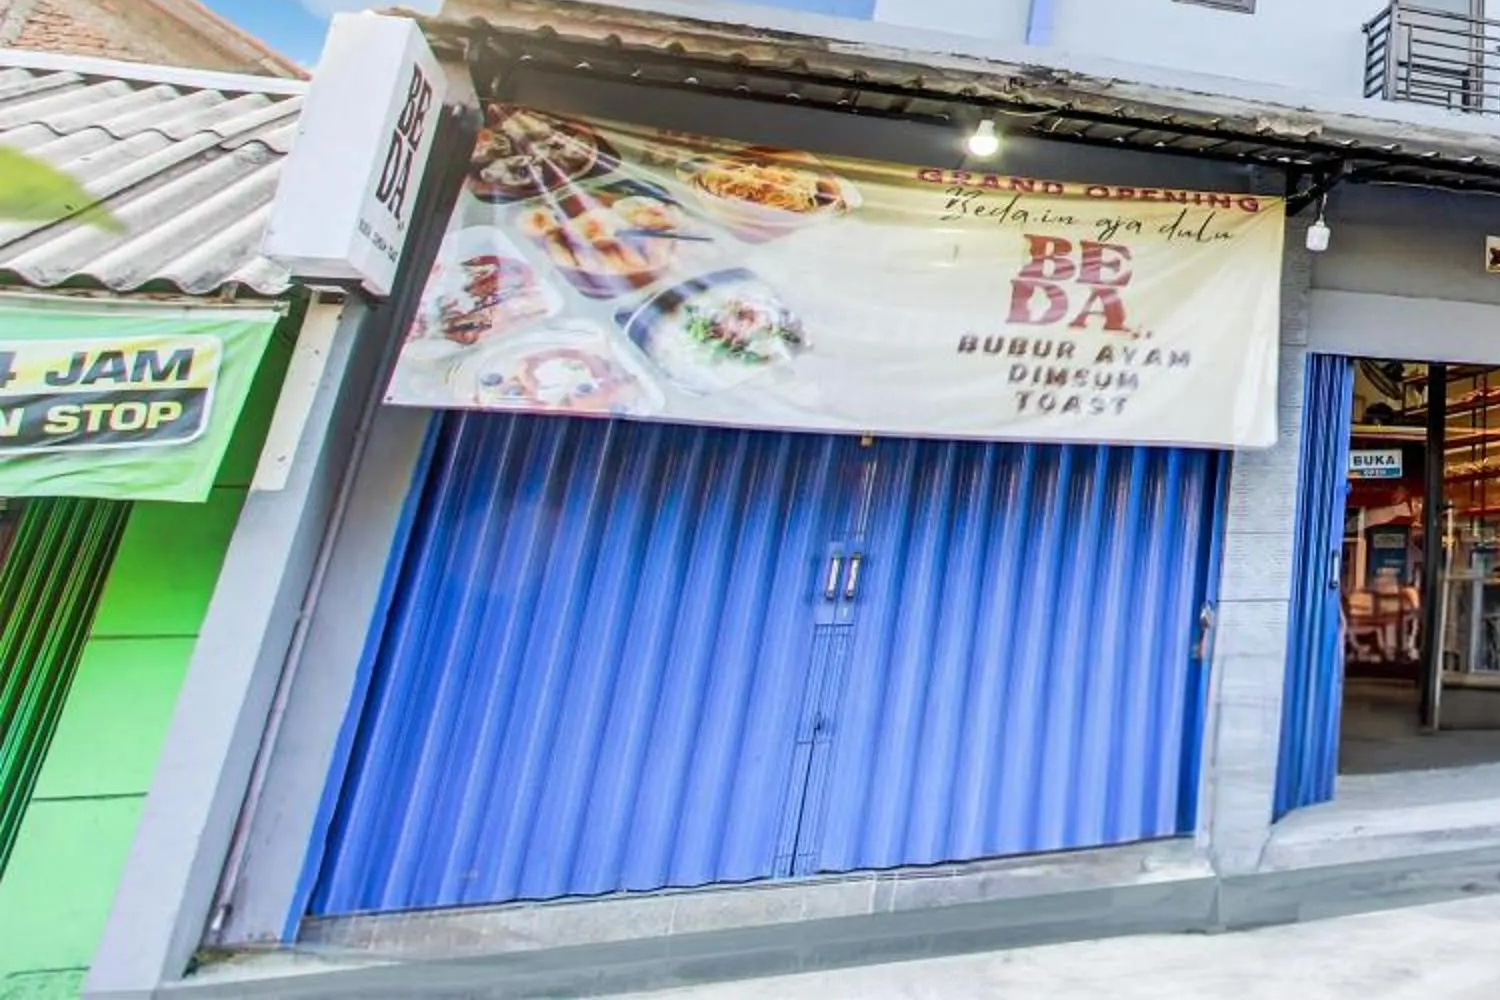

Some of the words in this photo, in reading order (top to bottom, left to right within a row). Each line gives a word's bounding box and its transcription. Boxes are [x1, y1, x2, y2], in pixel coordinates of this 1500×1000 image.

[917, 168, 1064, 197] GRAND
[1085, 185, 1260, 213] OPENING
[1018, 233, 1133, 287] BE
[45, 348, 195, 387] JAM
[957, 334, 1077, 359] BUBUR
[1095, 344, 1192, 368] AYAM
[1007, 363, 1141, 391] DIMSUM
[43, 401, 183, 434] STOP
[1014, 390, 1132, 416] TOAST
[1353, 455, 1395, 466] BUKA
